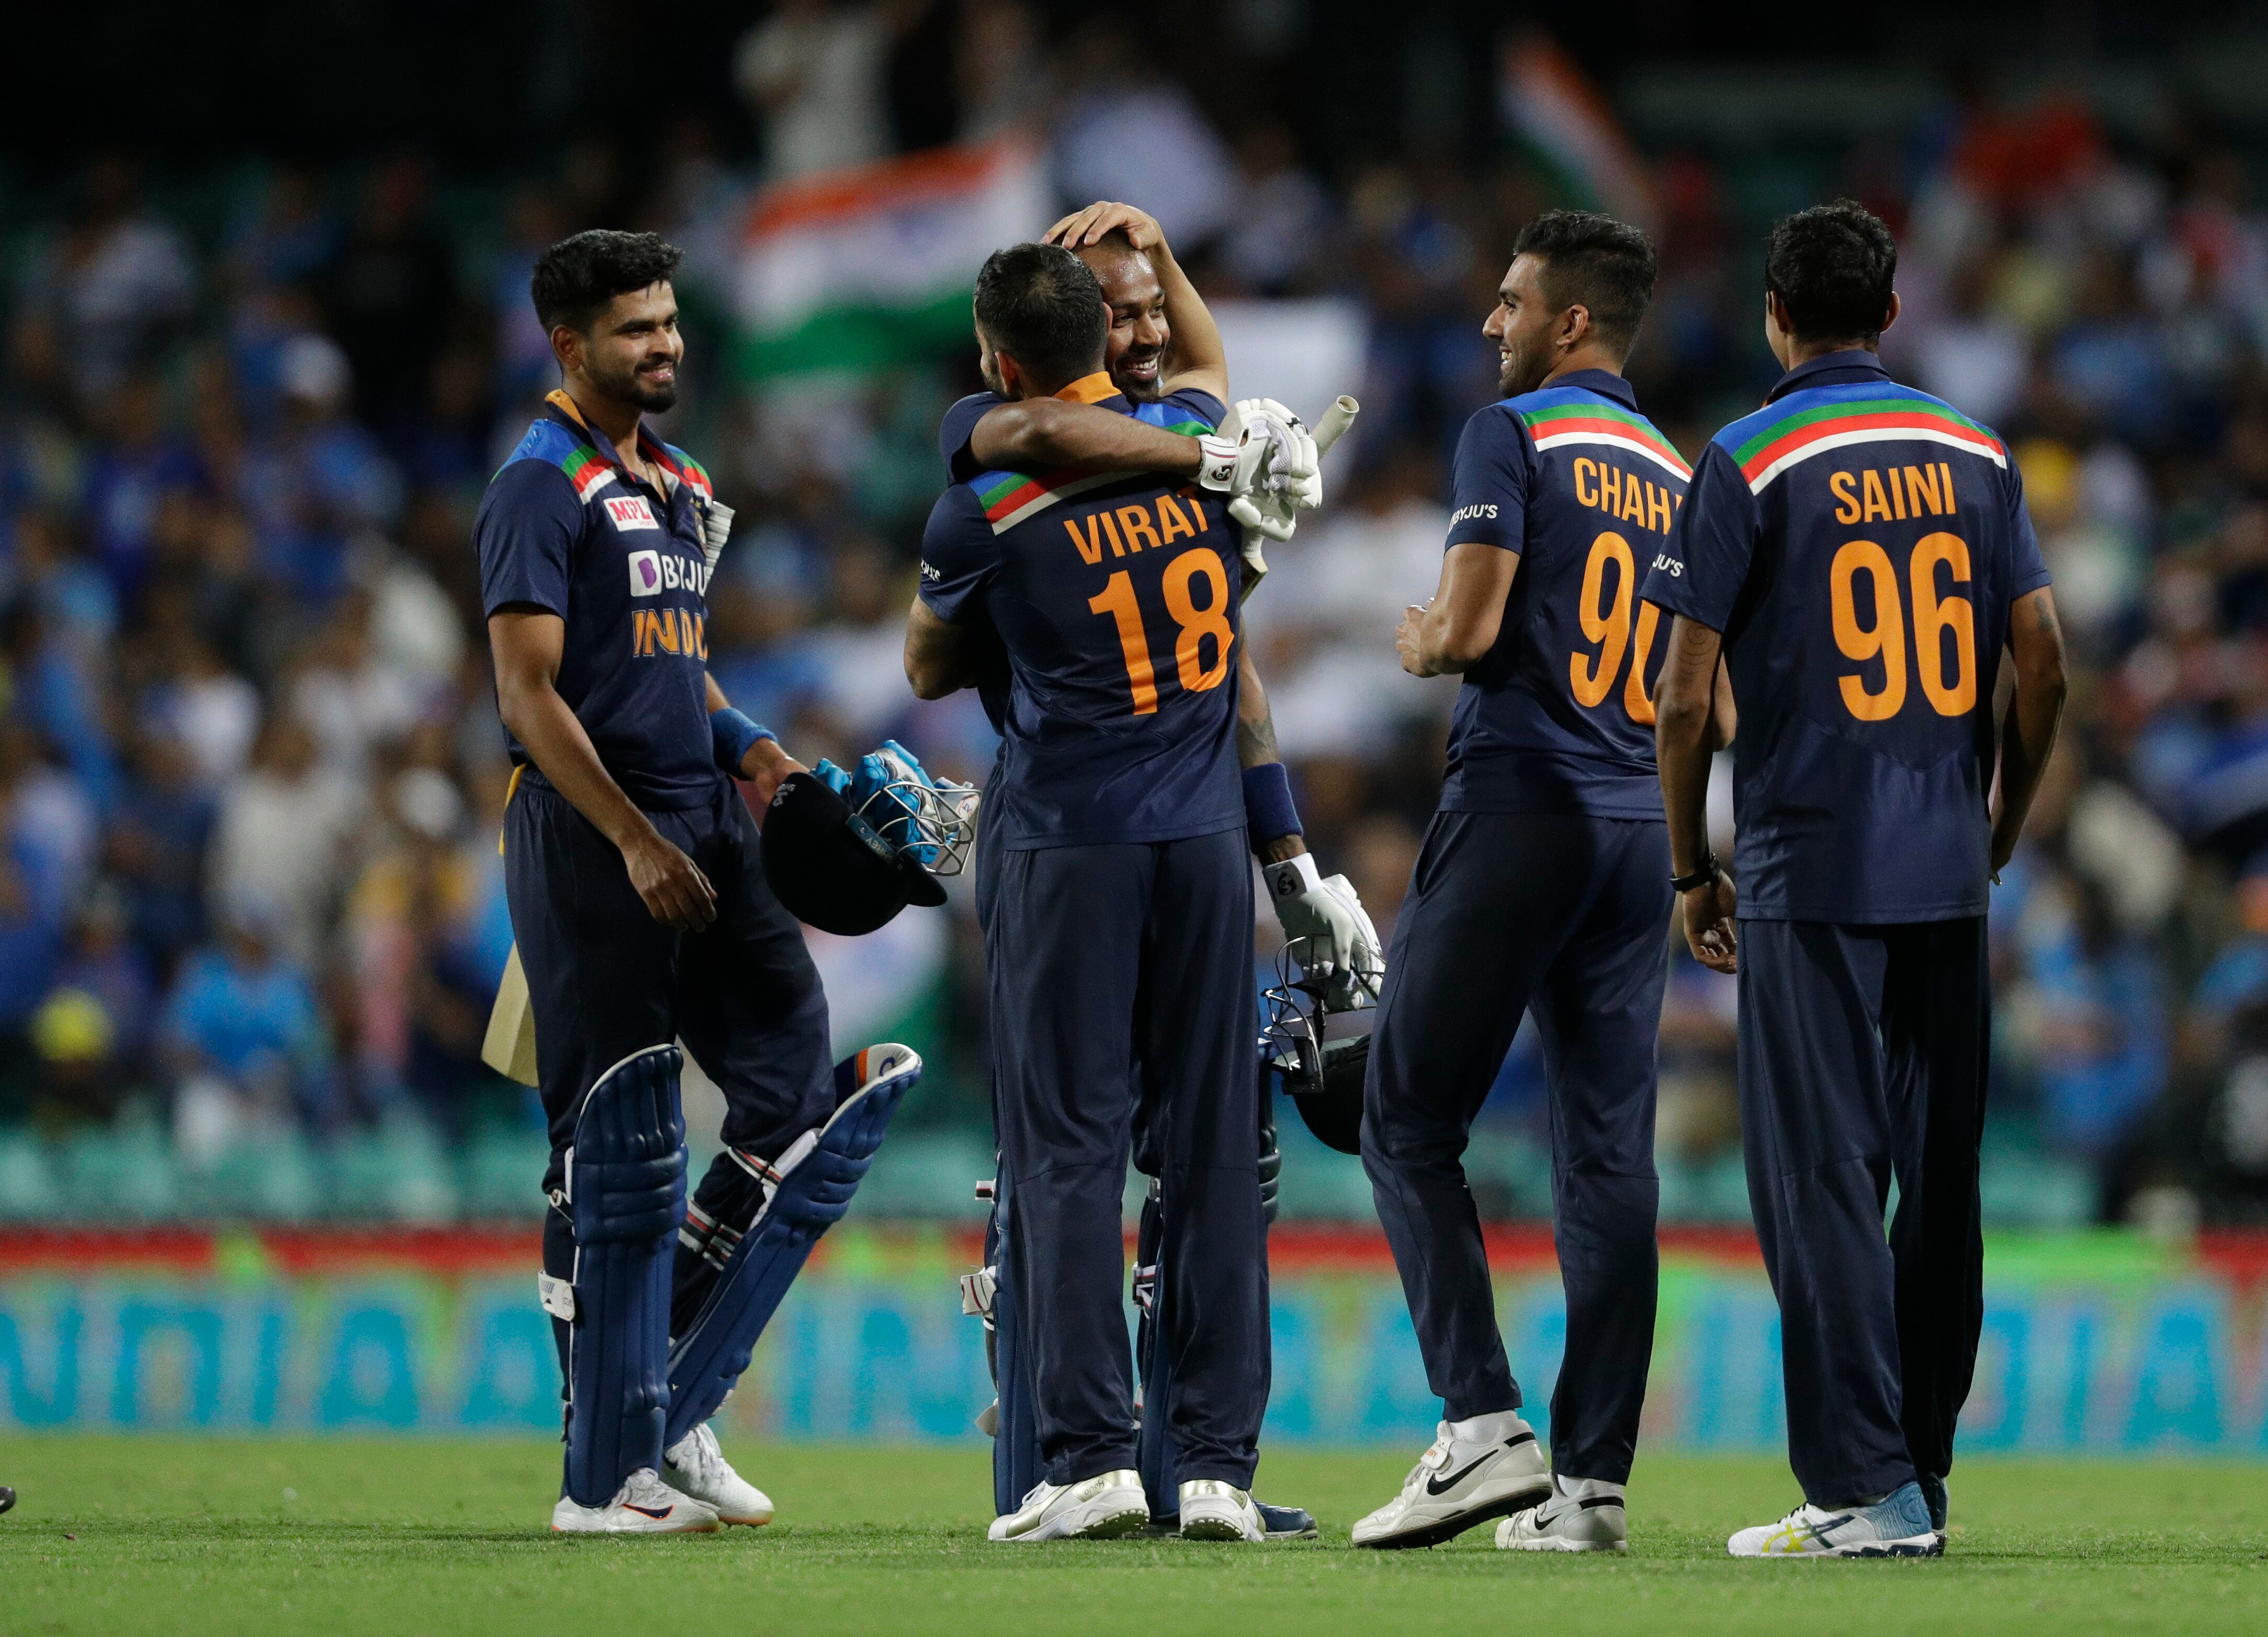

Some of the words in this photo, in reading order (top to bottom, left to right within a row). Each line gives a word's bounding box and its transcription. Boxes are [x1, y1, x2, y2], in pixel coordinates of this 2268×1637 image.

[608, 500, 651, 522] MPL
[1064, 483, 1209, 565] VIRAT
[1453, 504, 1498, 525] BYJU'S
[1574, 457, 1683, 535] CHAH
[1830, 462, 1957, 525] SAINI
[1652, 553, 1684, 578] JU'S
[631, 607, 709, 662] INDI
[1088, 547, 1235, 716] 18
[1830, 532, 1977, 721] 96
